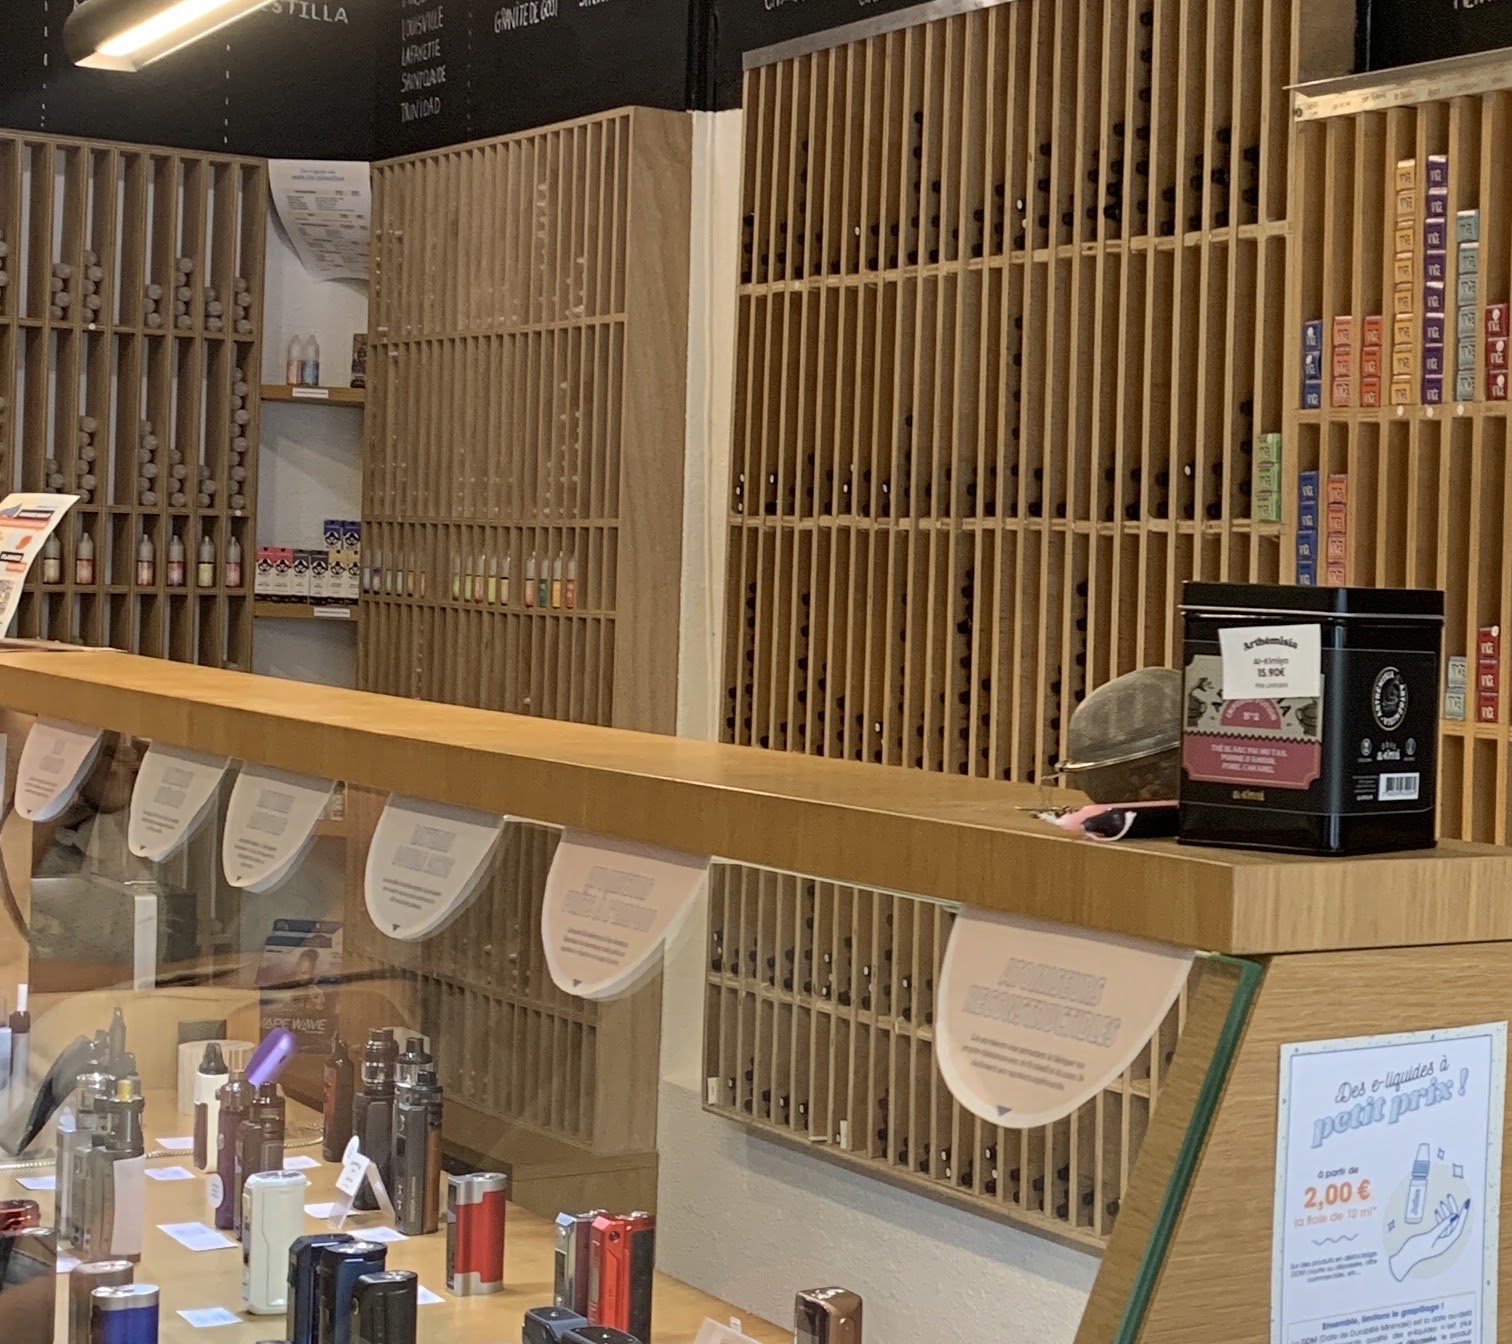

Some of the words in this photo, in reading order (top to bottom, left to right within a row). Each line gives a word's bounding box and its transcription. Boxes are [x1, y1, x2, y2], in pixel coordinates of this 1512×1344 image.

[1312, 1095, 1387, 1149] petit
[1388, 1077, 1454, 1125] prix
[1304, 1181, 1352, 1211] 2,00
